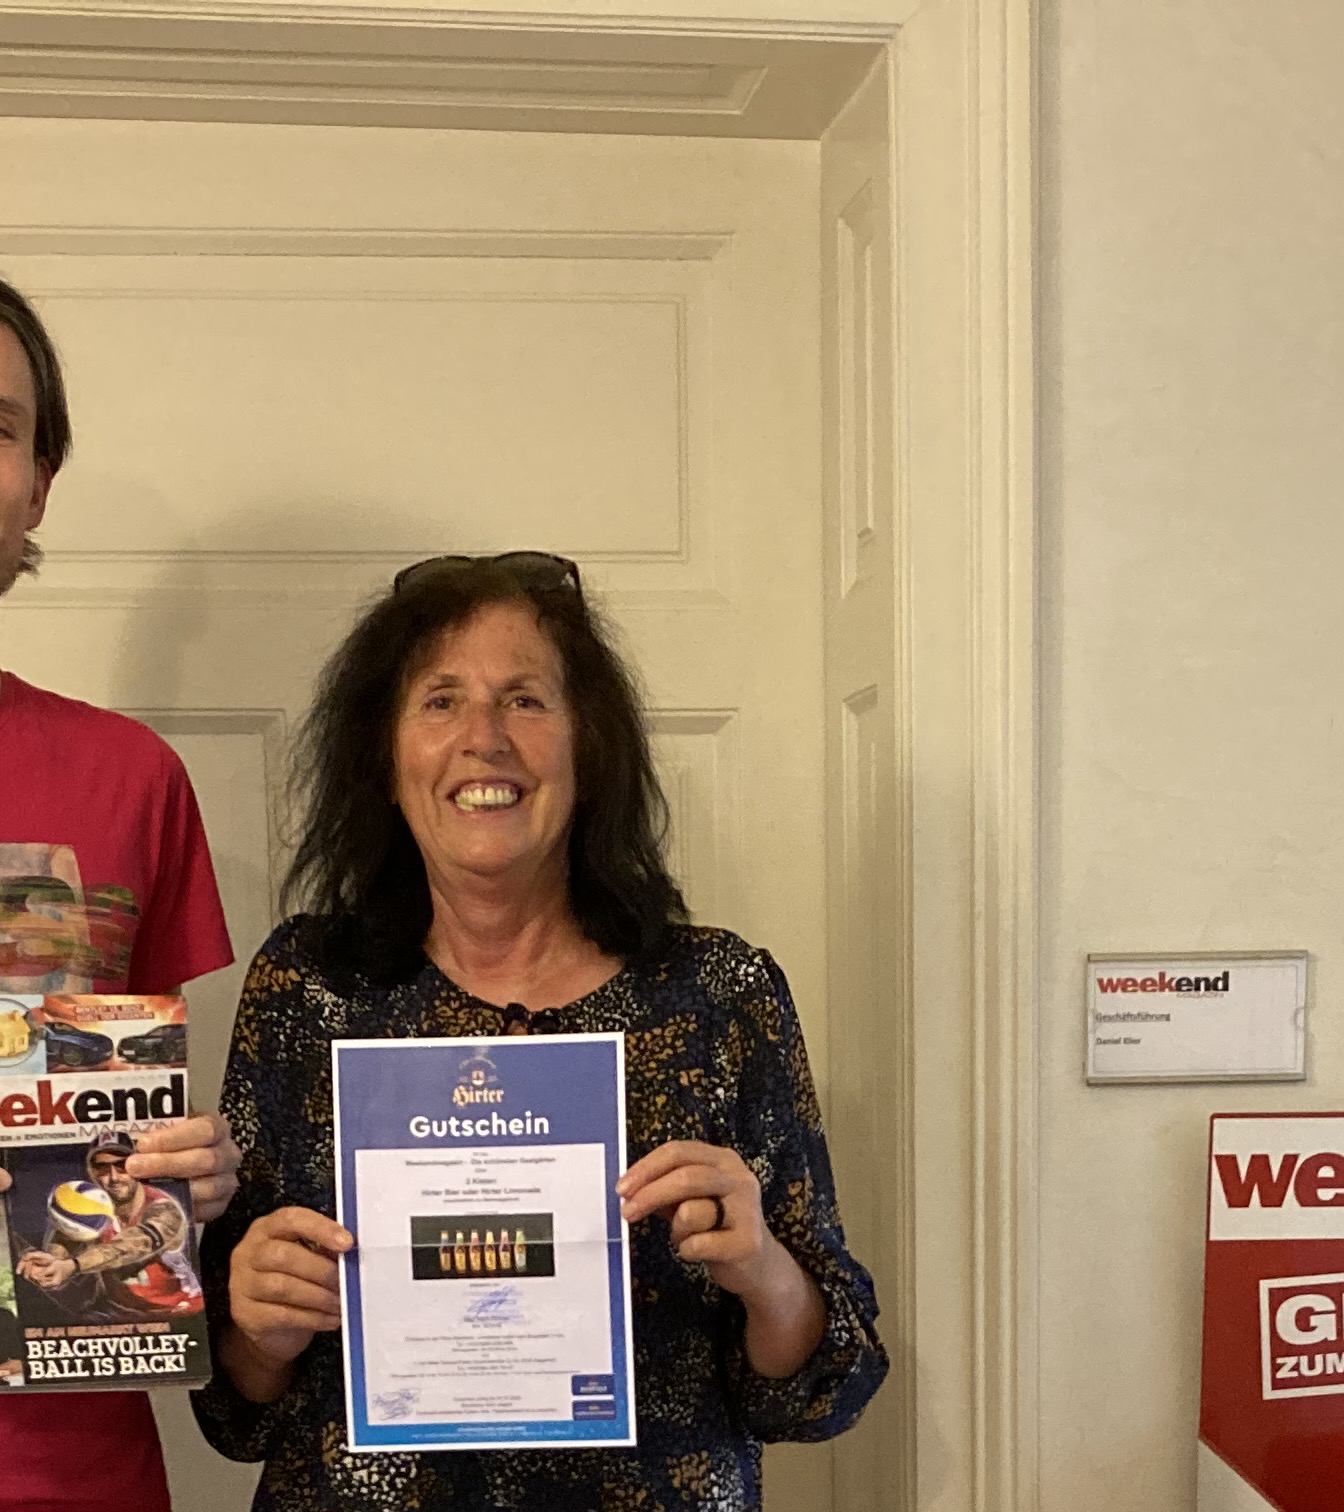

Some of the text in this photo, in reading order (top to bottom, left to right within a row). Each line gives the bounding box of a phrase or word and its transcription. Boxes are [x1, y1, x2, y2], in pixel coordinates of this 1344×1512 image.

[1097, 971, 1230, 994] weekend
[452, 1085, 504, 1108] Hirter
[409, 1111, 549, 1137] Gutschein
[25, 1334, 198, 1359] BEACHVOLLEY-
[28, 1359, 90, 1379] BALL
[93, 1357, 115, 1376] IS
[118, 1354, 186, 1375] BACK!
